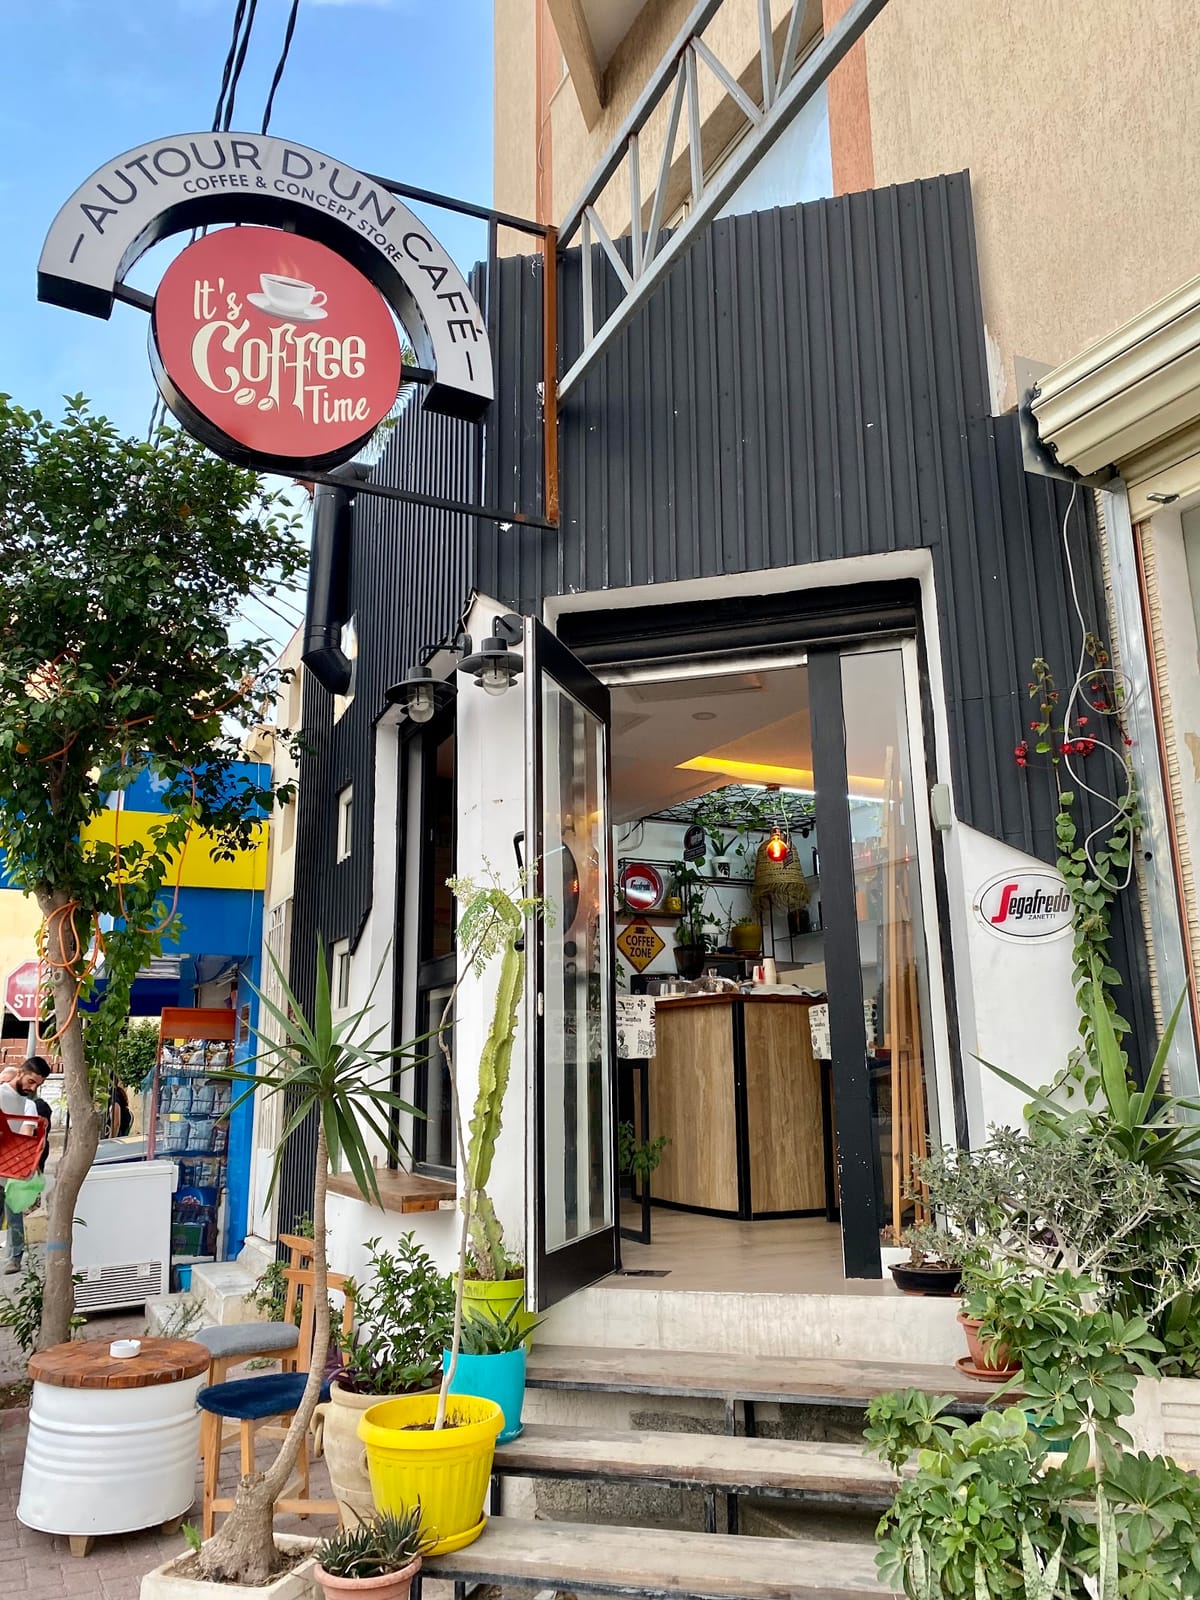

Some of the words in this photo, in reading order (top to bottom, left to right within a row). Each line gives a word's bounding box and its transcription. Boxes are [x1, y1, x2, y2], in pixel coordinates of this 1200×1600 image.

[183, 174, 249, 193] COFFEE
[256, 176, 267, 188] &
[273, 179, 356, 221] CONCEPT
[357, 219, 404, 263] STORE
[80, 140, 261, 234] AUTOUR
[402, 232, 483, 344] CAFÉ
[193, 277, 243, 321] It's
[191, 319, 366, 421] Coffee
[304, 385, 370, 425] Time
[991, 884, 1070, 923] Segafredo
[625, 935, 655, 948] COFFEE
[630, 947, 652, 958] ZONE
[13, 994, 46, 1009] STO
